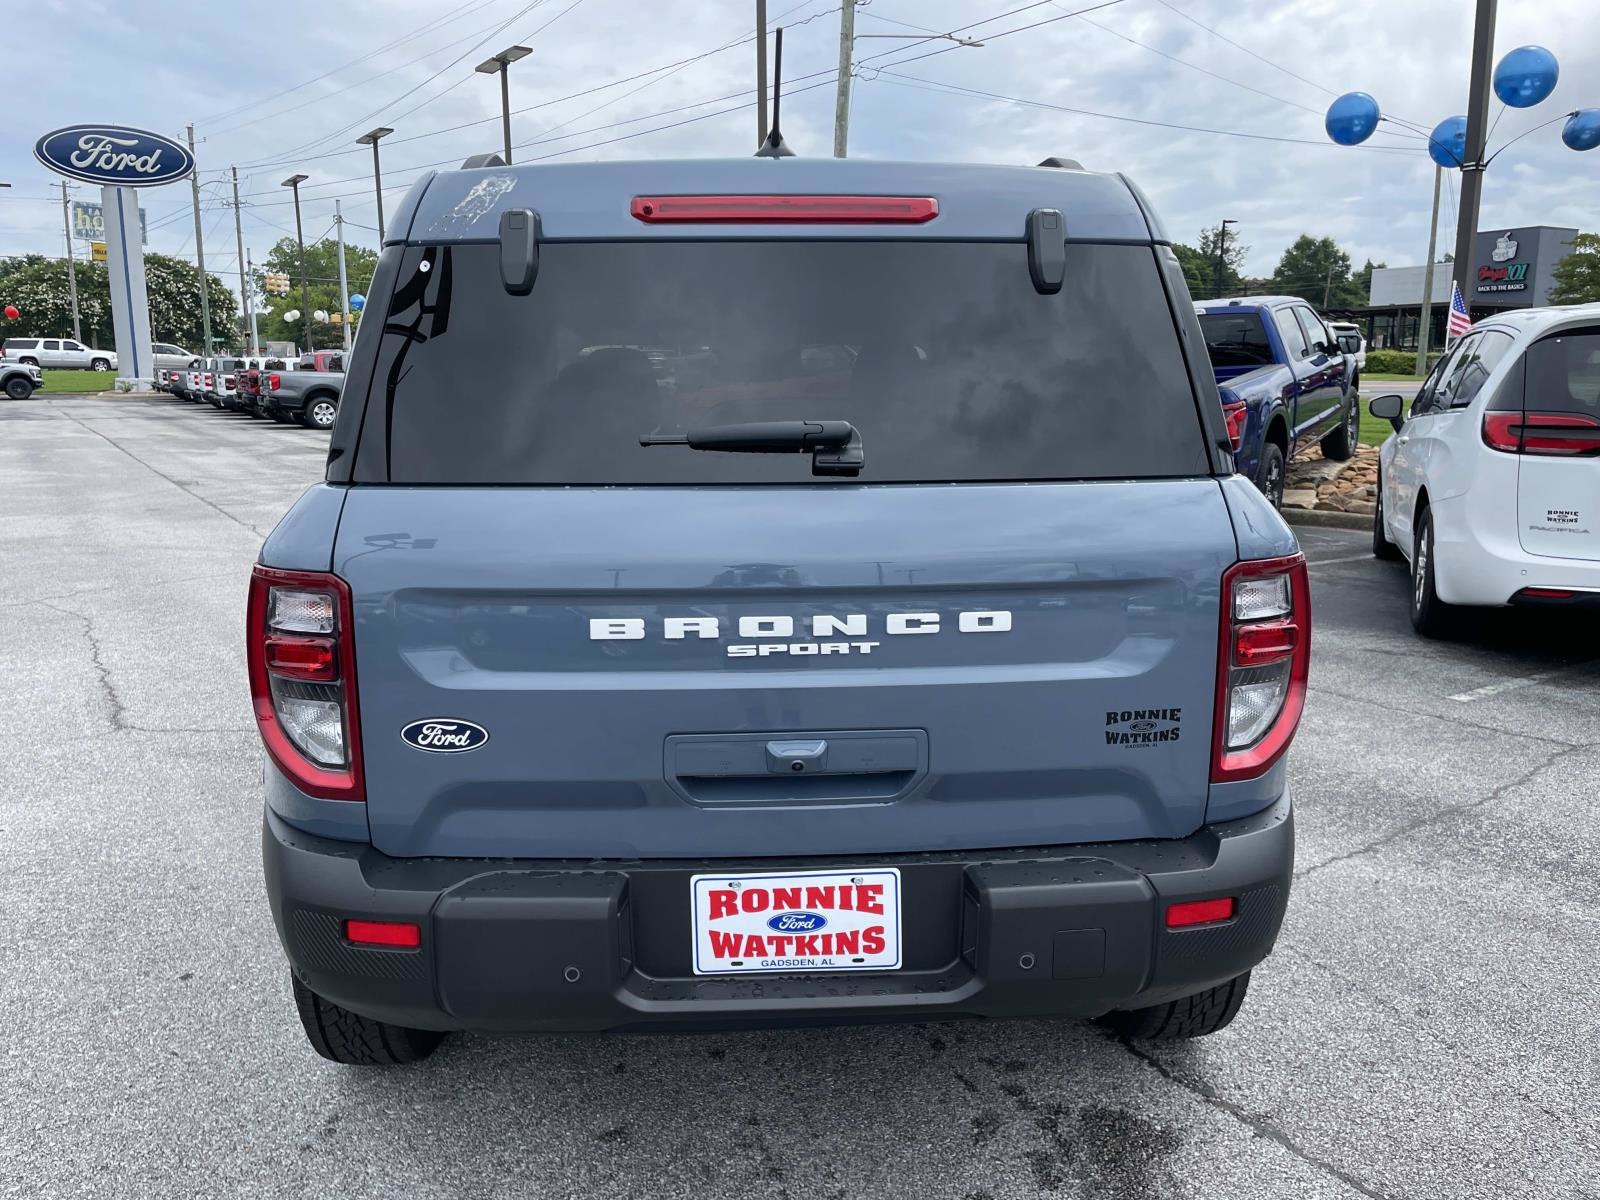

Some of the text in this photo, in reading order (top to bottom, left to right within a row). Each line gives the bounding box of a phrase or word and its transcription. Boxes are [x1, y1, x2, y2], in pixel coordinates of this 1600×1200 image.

[70, 134, 162, 173] Ford
[589, 610, 1012, 640] BRONCO
[727, 641, 880, 657] SPORT
[1105, 708, 1182, 726] RONNIE
[417, 723, 471, 746] Ford
[1105, 727, 1181, 745] WATKINS
[708, 884, 884, 921] RONNIE
[778, 914, 817, 930] Ford
[708, 926, 886, 959] WATKINS
[761, 957, 836, 967] GADSDEN, AL
